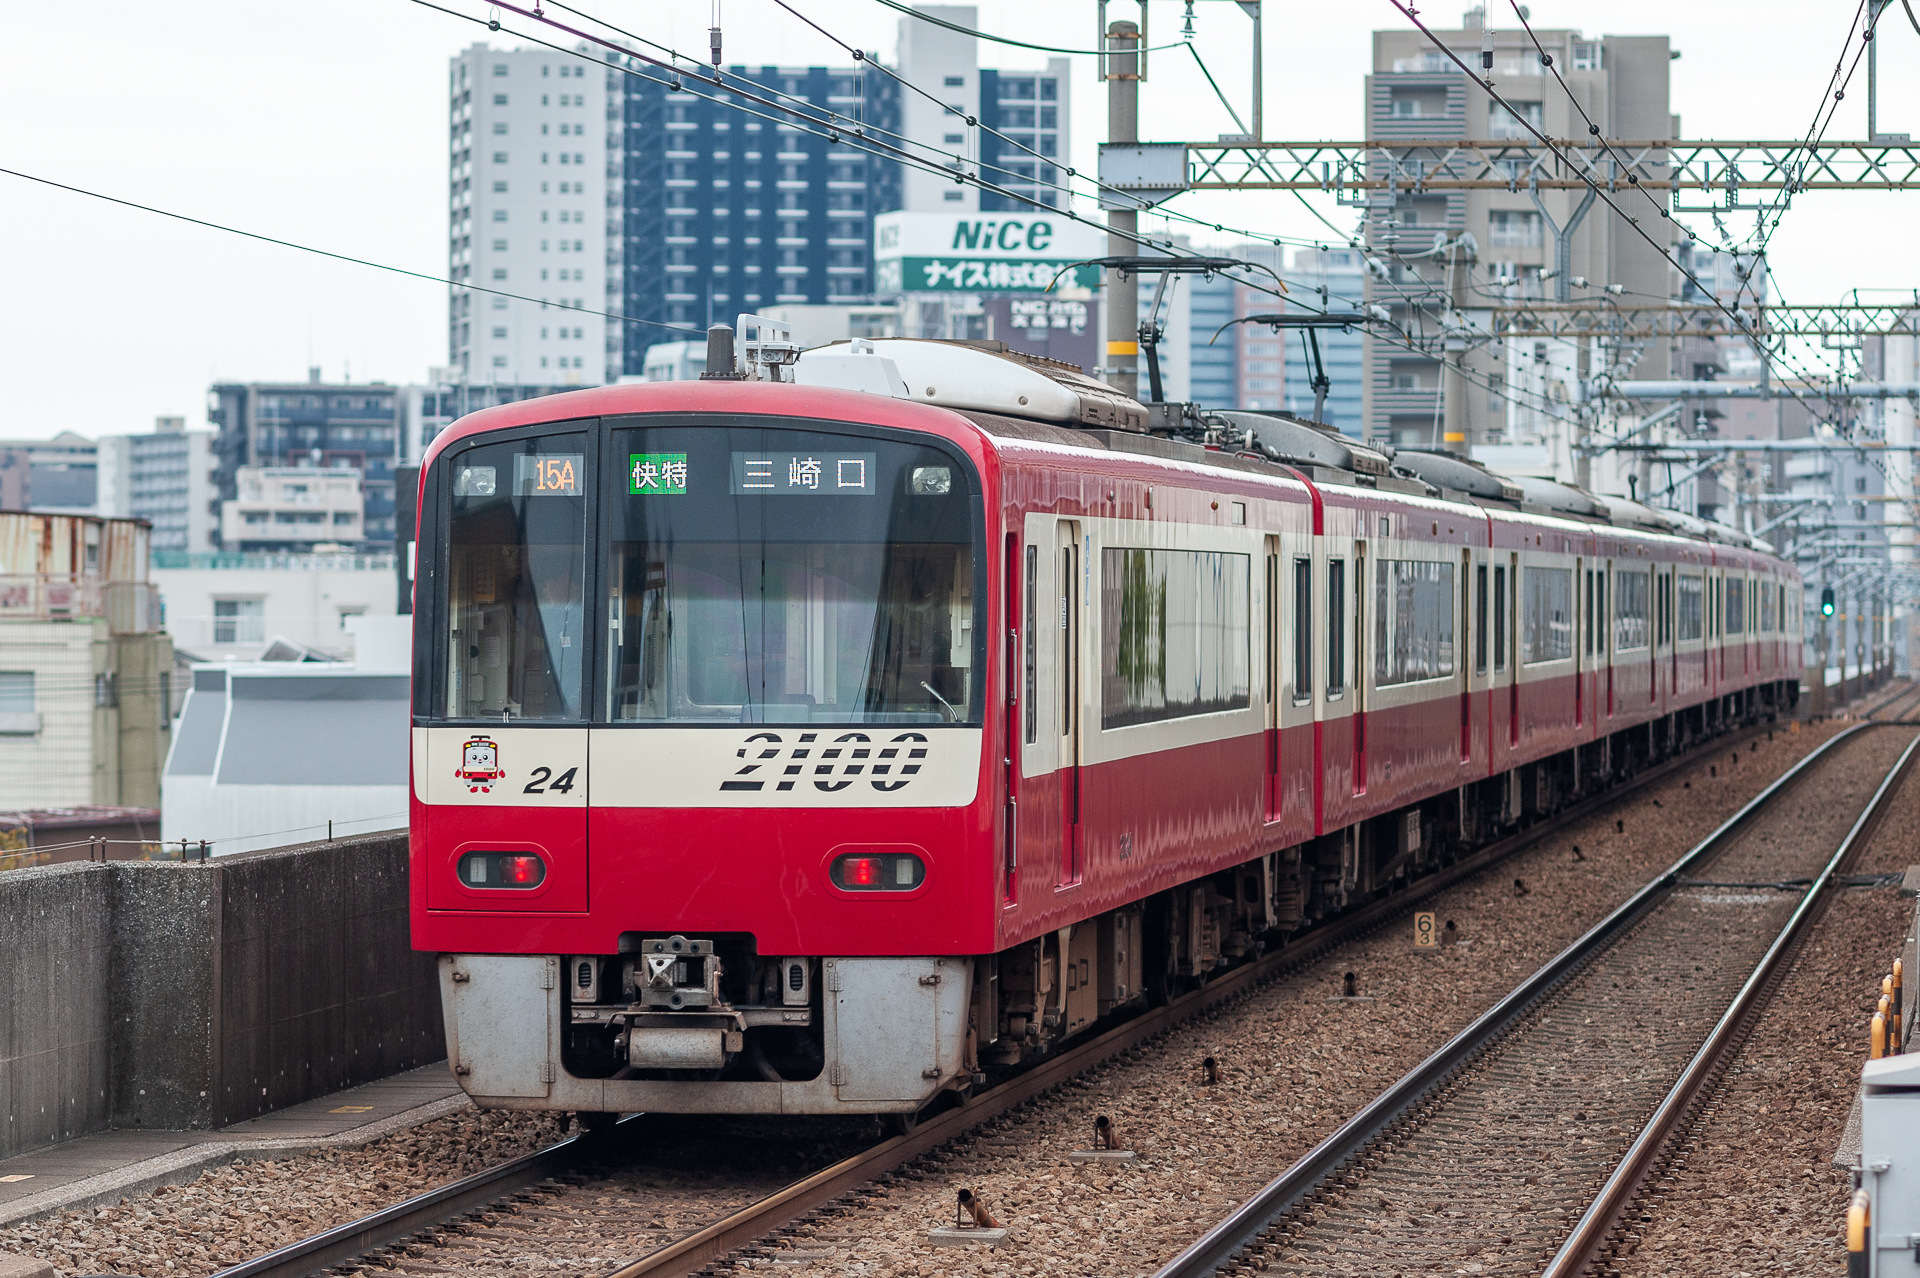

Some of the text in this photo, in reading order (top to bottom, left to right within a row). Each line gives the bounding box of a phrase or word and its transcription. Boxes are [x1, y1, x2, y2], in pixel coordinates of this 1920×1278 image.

[952, 221, 1053, 250] Nice
[923, 260, 1079, 288] ナイス株式会社
[536, 460, 575, 490] 15A
[632, 460, 687, 489] 快特
[743, 457, 865, 489] 三崎口
[719, 732, 929, 791] 2100
[522, 766, 579, 794] 24
[1418, 914, 1432, 933] 6
[1420, 933, 1430, 945] 3
